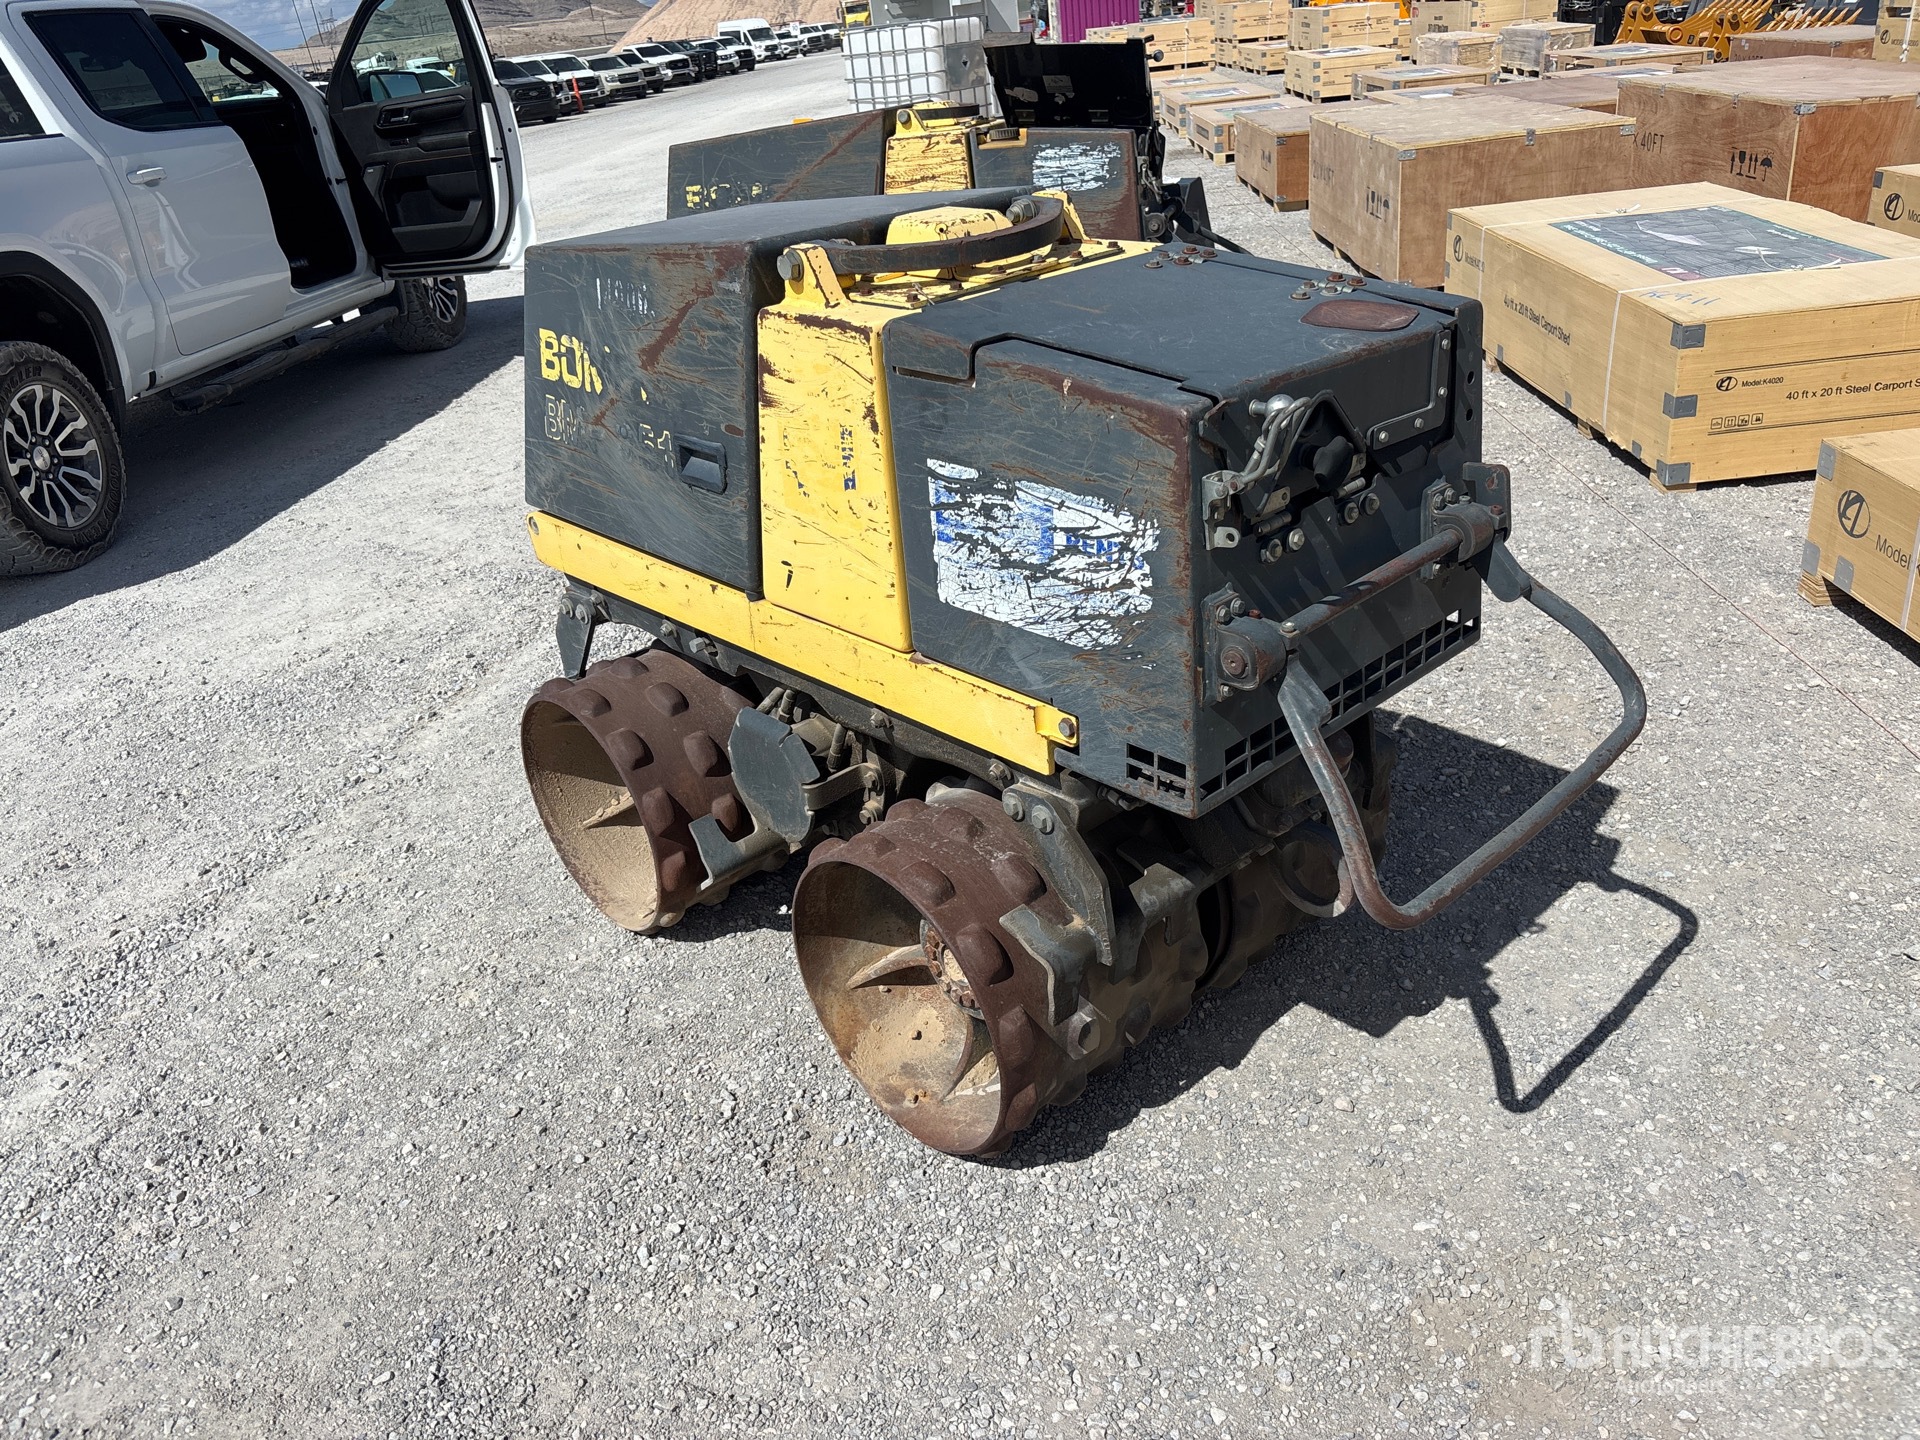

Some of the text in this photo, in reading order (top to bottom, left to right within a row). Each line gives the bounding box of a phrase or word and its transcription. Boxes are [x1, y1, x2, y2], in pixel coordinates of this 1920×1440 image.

[1529, 307, 1540, 326] Steel
[1541, 315, 1557, 337] Carport
[1558, 326, 1570, 346] Shed
[1741, 377, 1784, 387] Model:K4020
[1786, 391, 1799, 400] 40
[1801, 389, 1809, 399] ft
[1820, 388, 1833, 397] 20
[1835, 386, 1843, 395] ft
[1845, 383, 1871, 394] Steel
[1874, 379, 1912, 392] Carport
